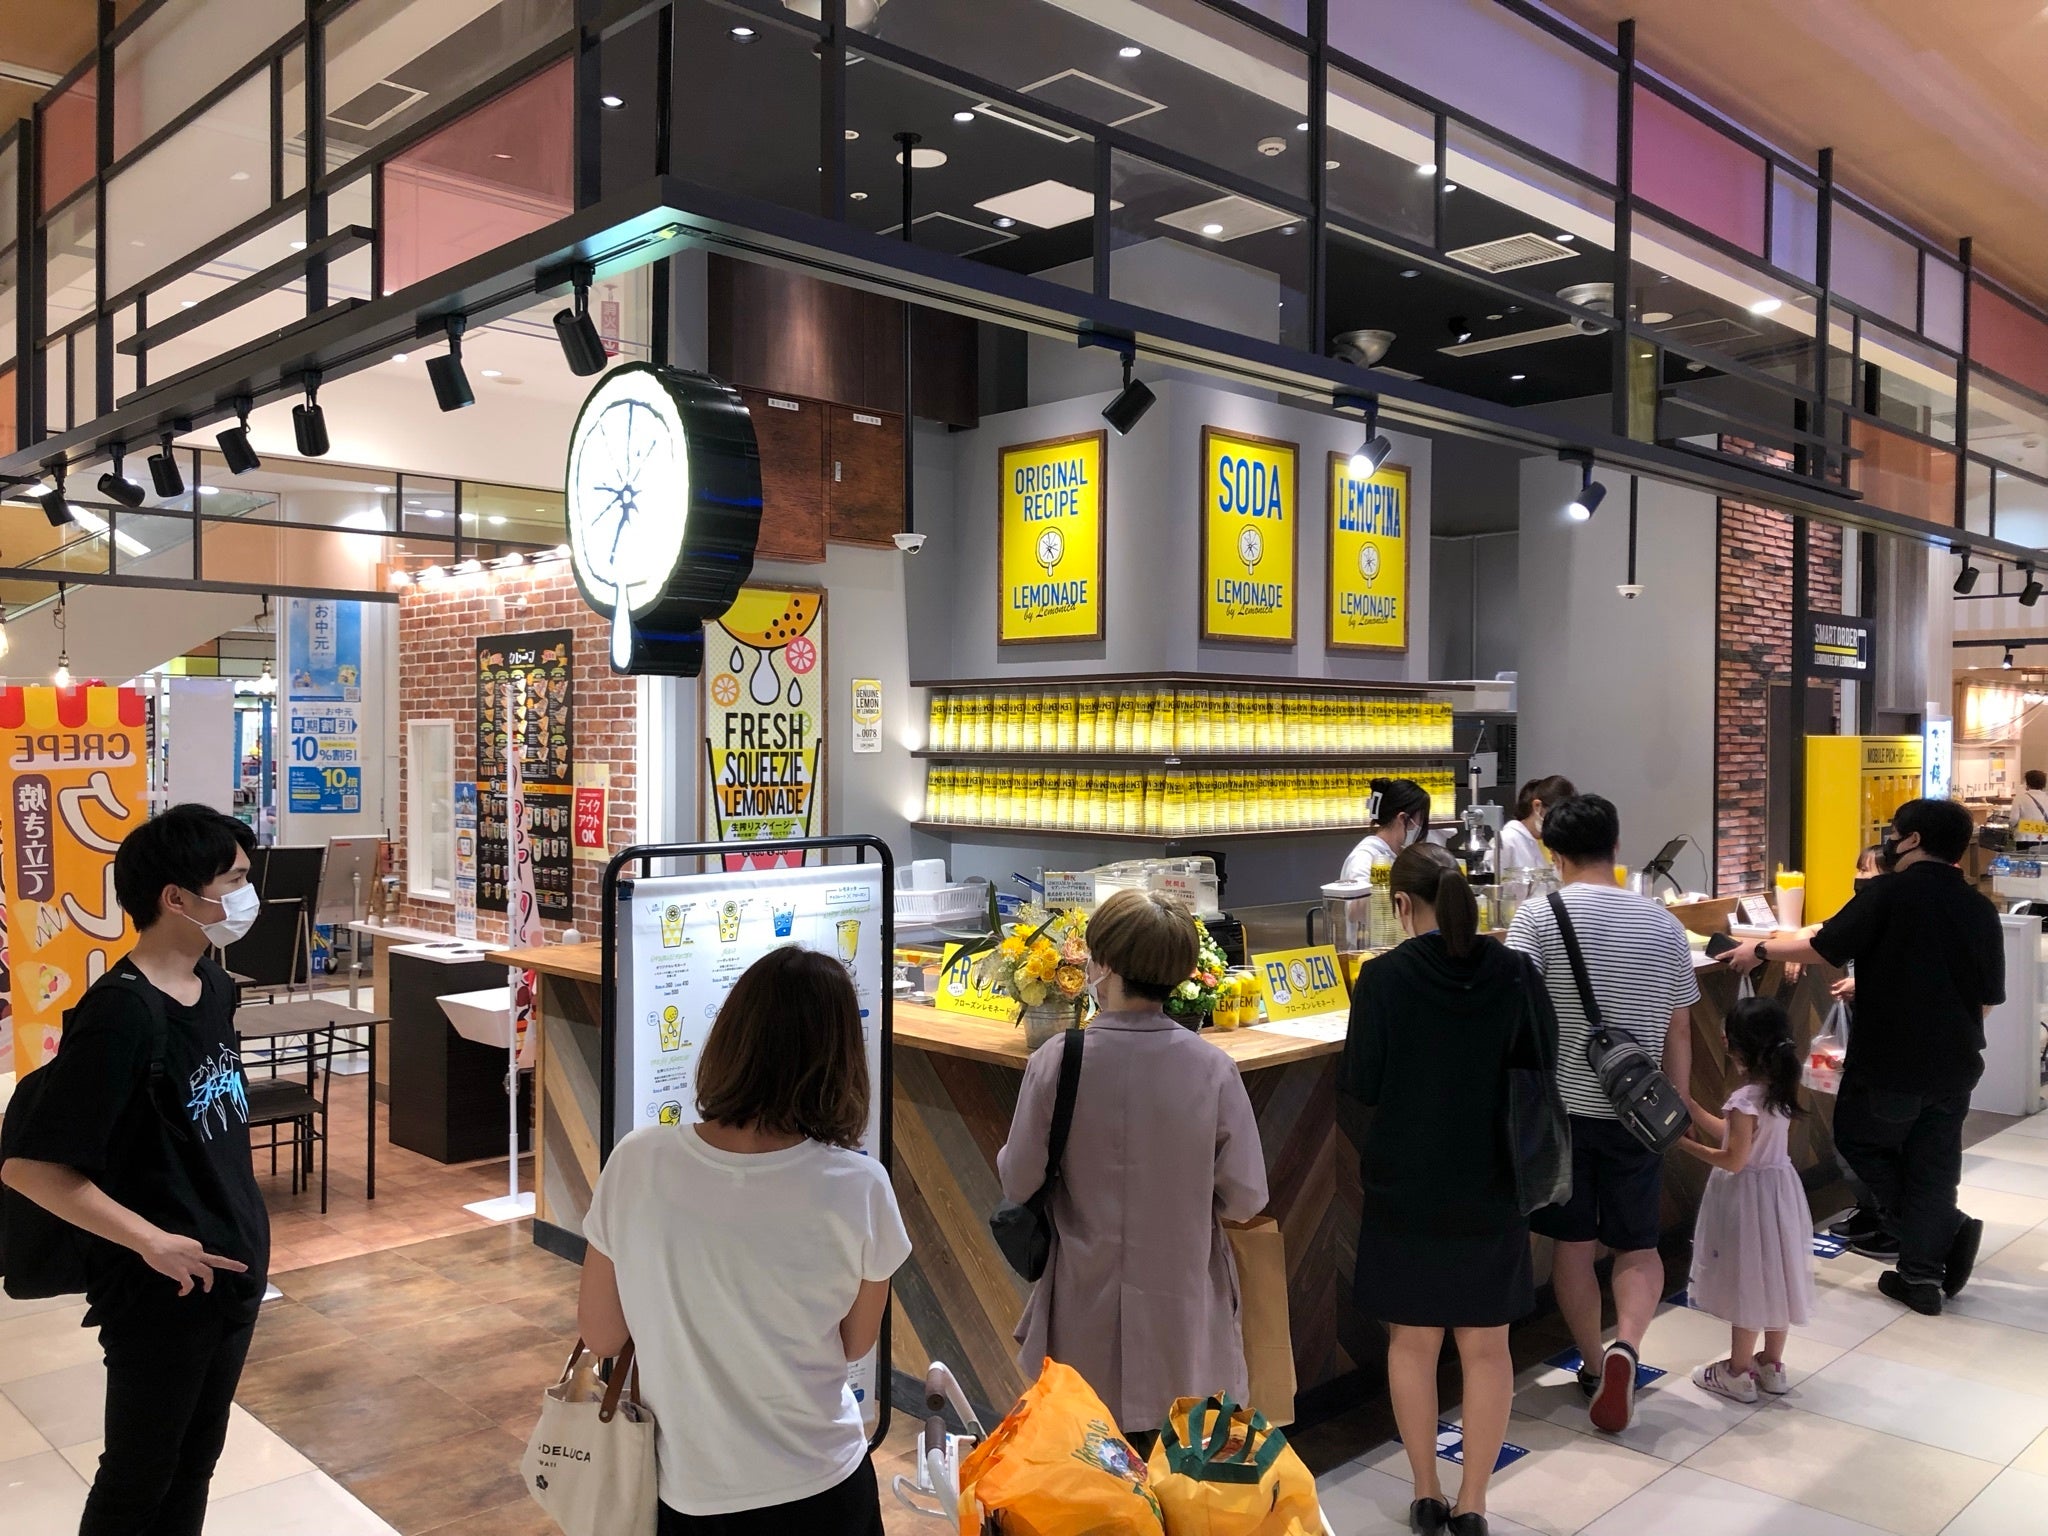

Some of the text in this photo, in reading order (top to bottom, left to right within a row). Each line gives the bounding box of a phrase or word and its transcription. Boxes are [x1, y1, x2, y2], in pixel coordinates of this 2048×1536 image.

[1015, 458, 1088, 495] ORIGINAL
[1218, 455, 1283, 520] SODA
[1024, 489, 1079, 522] RECIPE
[1339, 478, 1401, 538] LEMOPINA
[1013, 580, 1088, 609] LEMONADE
[1216, 578, 1283, 608] LEMONADE
[1340, 591, 1397, 618] LEMONADE
[314, 604, 330, 650] お中元
[1815, 623, 1858, 647] SMART ORDER
[855, 689, 879, 698] GENUINE
[856, 698, 879, 708] LEMON
[725, 712, 804, 749] FRESH
[1867, 747, 1885, 763] MOBILE
[725, 751, 803, 789] SQUEEZIE
[578, 798, 600, 813] テイク
[725, 787, 804, 817] LEMONADE
[578, 814, 600, 828] アウト
[581, 829, 596, 844] OK
